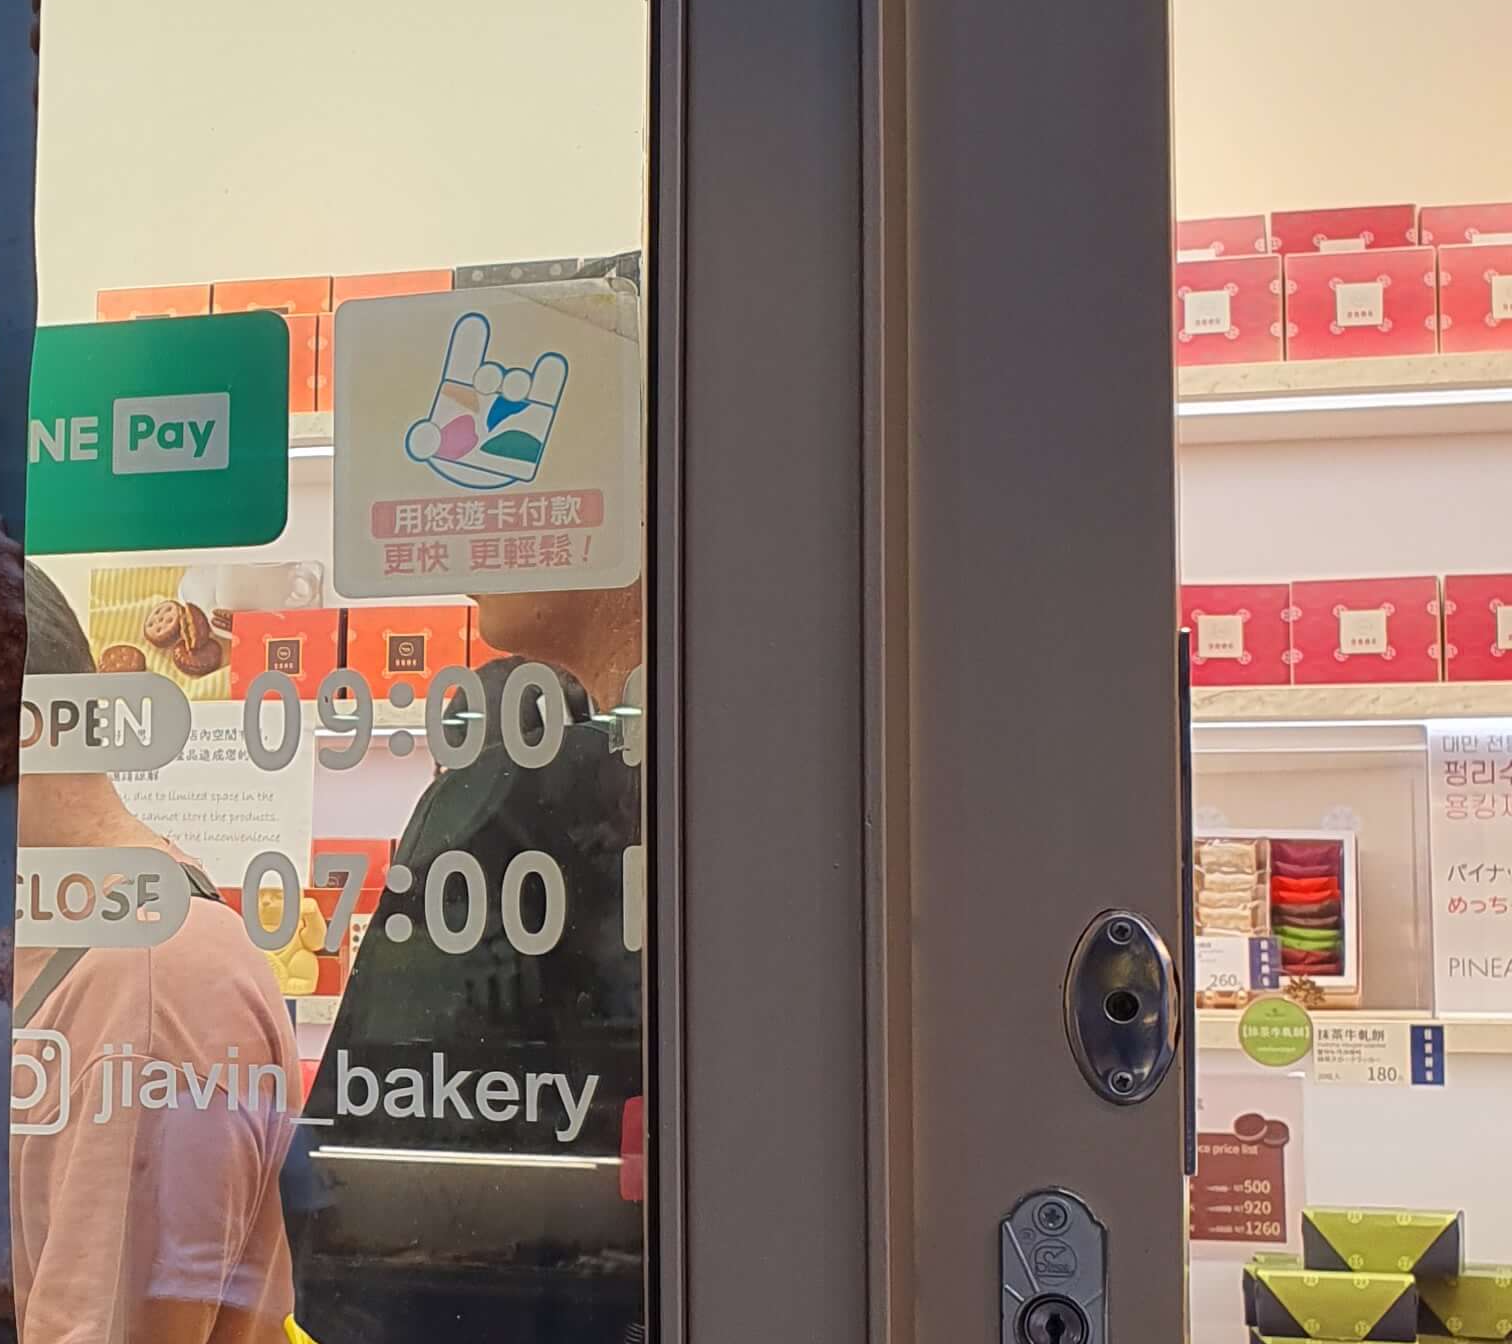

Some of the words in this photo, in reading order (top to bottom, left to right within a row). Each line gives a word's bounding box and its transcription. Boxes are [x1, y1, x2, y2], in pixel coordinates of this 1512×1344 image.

[29, 416, 99, 464] NE
[129, 414, 216, 458] Pay
[393, 495, 583, 535] 用悠遊卡付款
[384, 540, 449, 575] 更快
[243, 662, 565, 772] 09:00
[1442, 735, 1478, 753] 대만
[134, 791, 153, 802] due
[155, 791, 166, 802] to
[168, 790, 208, 802] limited
[211, 792, 239, 805] space
[256, 791, 275, 802] the
[142, 813, 179, 823] cannot
[210, 811, 226, 823] the
[184, 831, 201, 842] the
[203, 831, 281, 843] inconvenience
[16, 872, 161, 922] LOSE
[242, 850, 567, 956] 07:00
[1448, 896, 1512, 914] めっち
[1209, 974, 1238, 987] 260
[1367, 1066, 1398, 1082] 180
[1212, 1143, 1240, 1156] price
[1241, 1143, 1259, 1155] list
